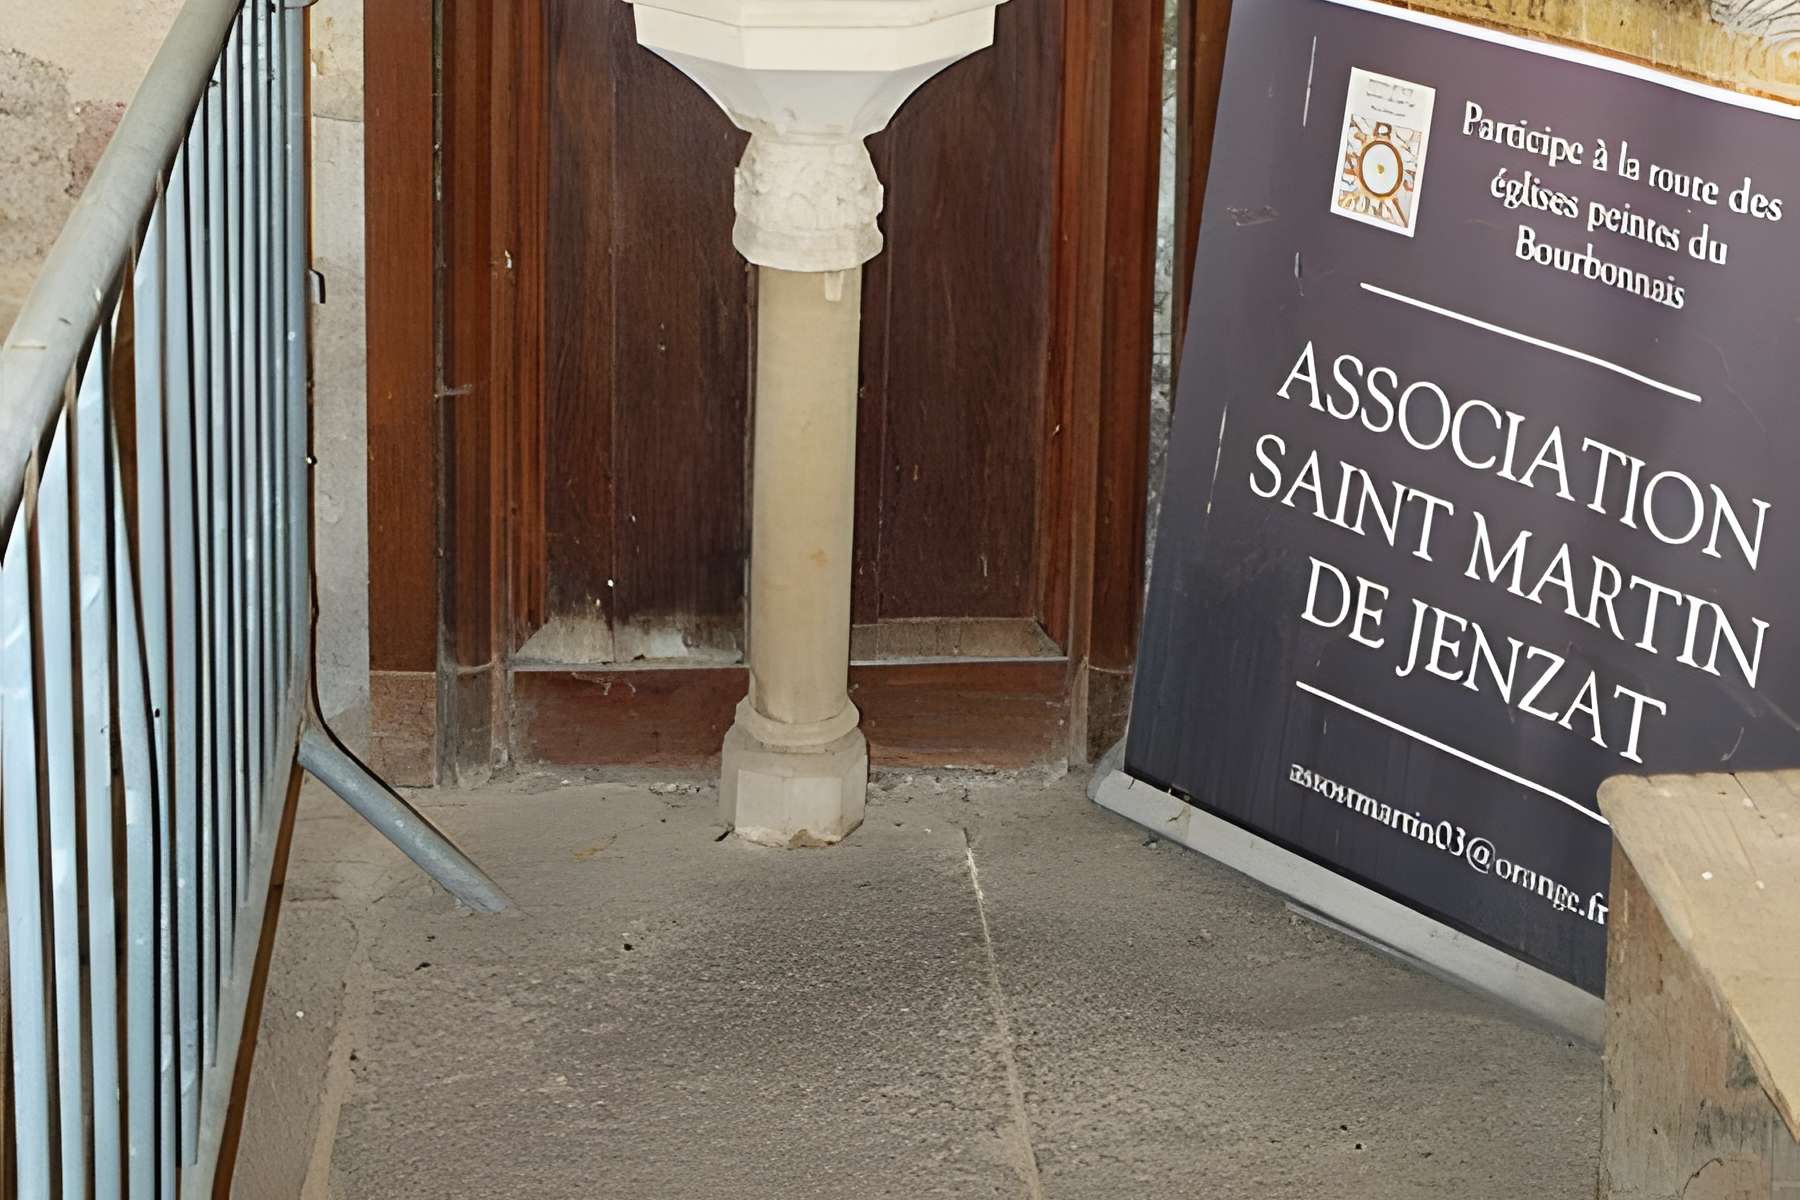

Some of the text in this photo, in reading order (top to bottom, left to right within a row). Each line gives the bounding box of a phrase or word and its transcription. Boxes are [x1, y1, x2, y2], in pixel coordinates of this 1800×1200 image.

[1462, 100, 1783, 222] Participe à la route des
[1490, 167, 1728, 265] églises peintes du
[1515, 224, 1685, 310] Bourbonnais
[1276, 340, 1772, 571] ASSOCIATION
[1249, 434, 1770, 689] SAINT MARTIN
[1301, 556, 1667, 764] DE JENZAT
